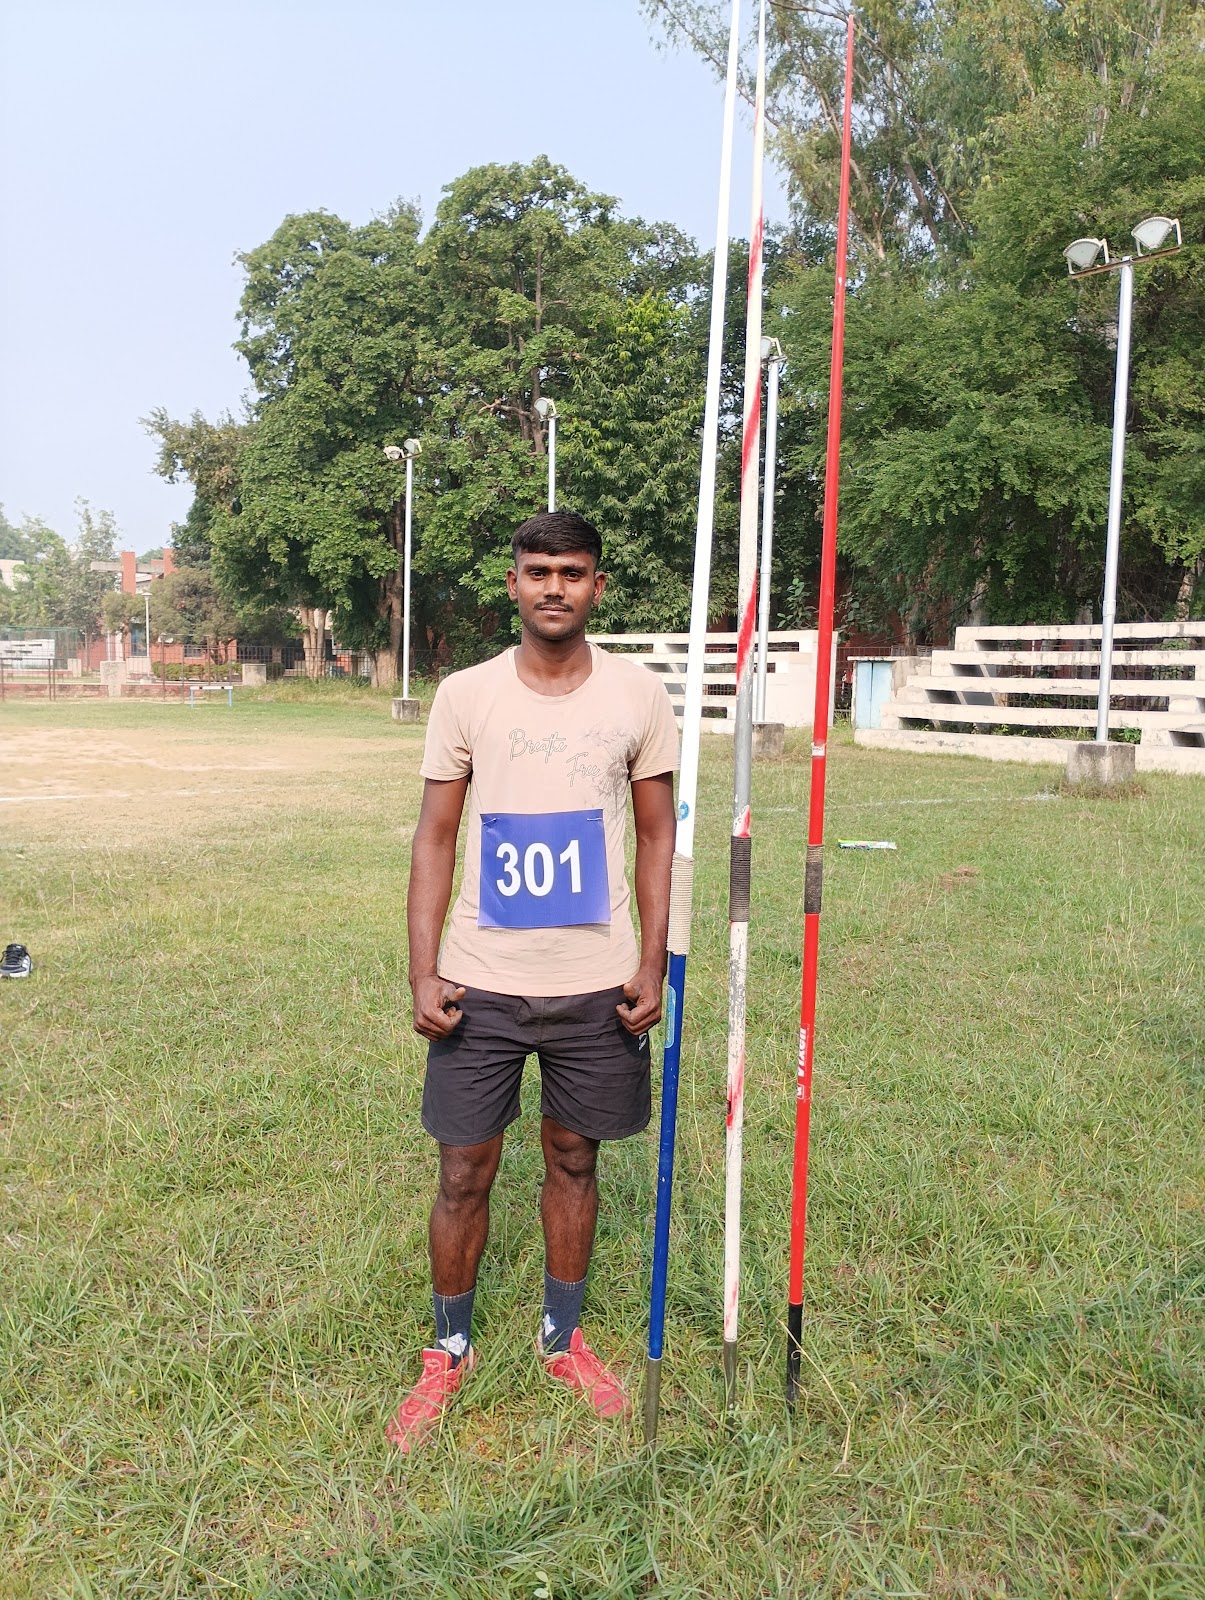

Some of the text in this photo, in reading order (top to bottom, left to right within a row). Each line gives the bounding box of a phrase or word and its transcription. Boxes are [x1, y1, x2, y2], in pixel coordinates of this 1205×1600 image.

[508, 728, 567, 764] Breathe
[565, 751, 601, 788] Free
[496, 839, 582, 897] 301
